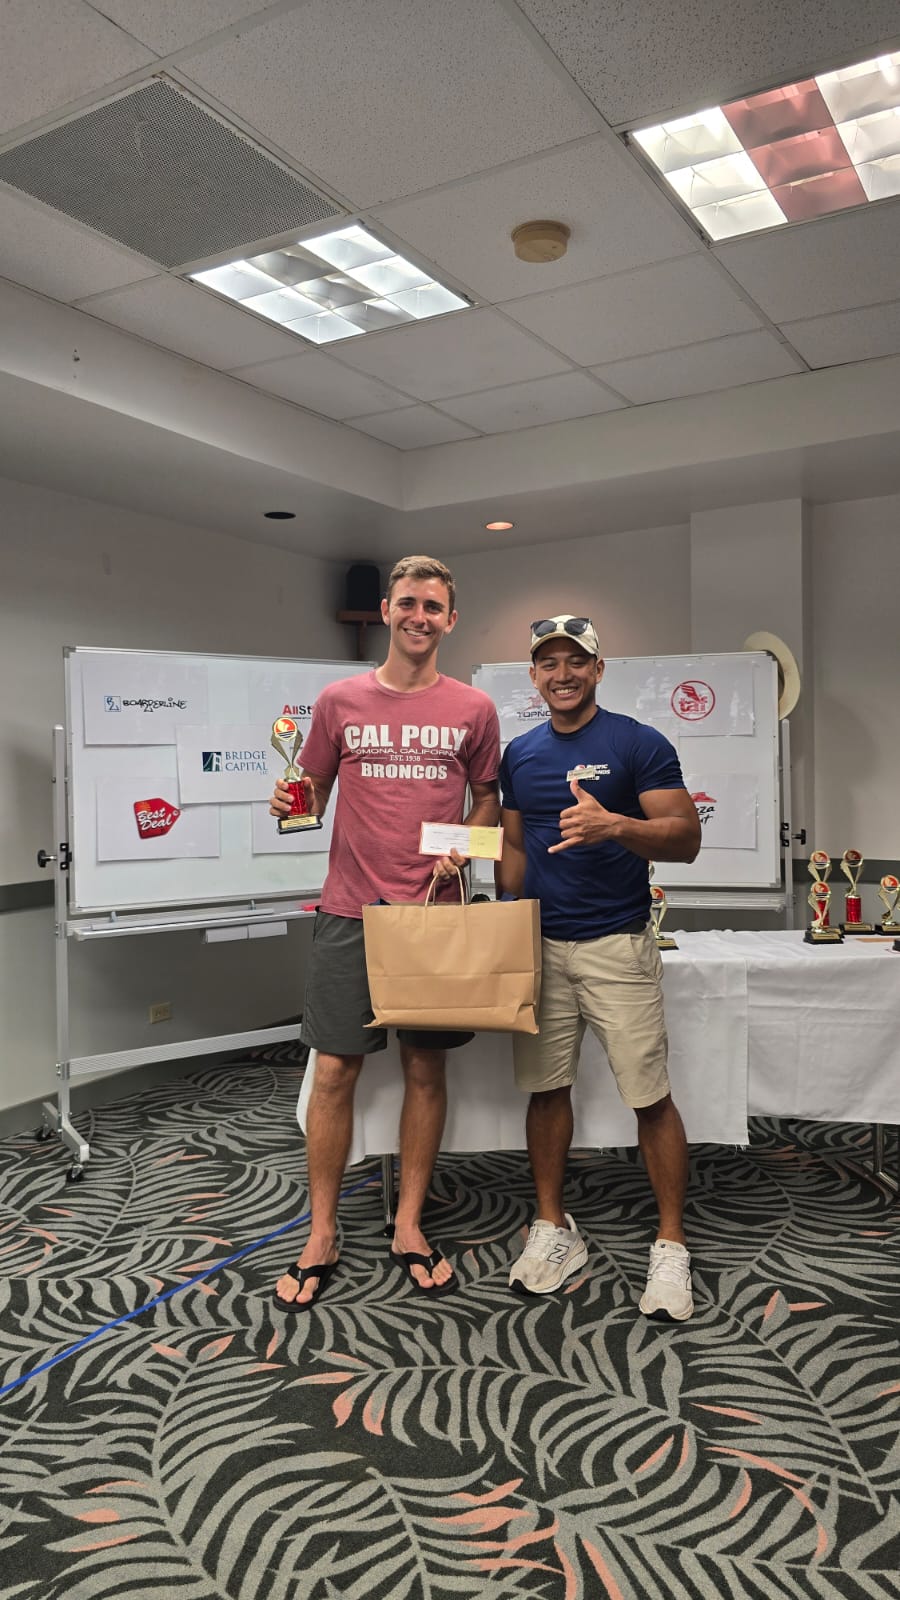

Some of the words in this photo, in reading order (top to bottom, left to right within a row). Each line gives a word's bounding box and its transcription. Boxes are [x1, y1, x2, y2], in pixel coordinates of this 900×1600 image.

[344, 725, 394, 749] CAL
[401, 725, 467, 751] POLY
[225, 751, 267, 760] BRIDGE
[225, 762, 268, 771] CAPITAL
[361, 762, 448, 780] BRONCOS
[137, 807, 166, 822] Best
[140, 813, 173, 831] Deal
